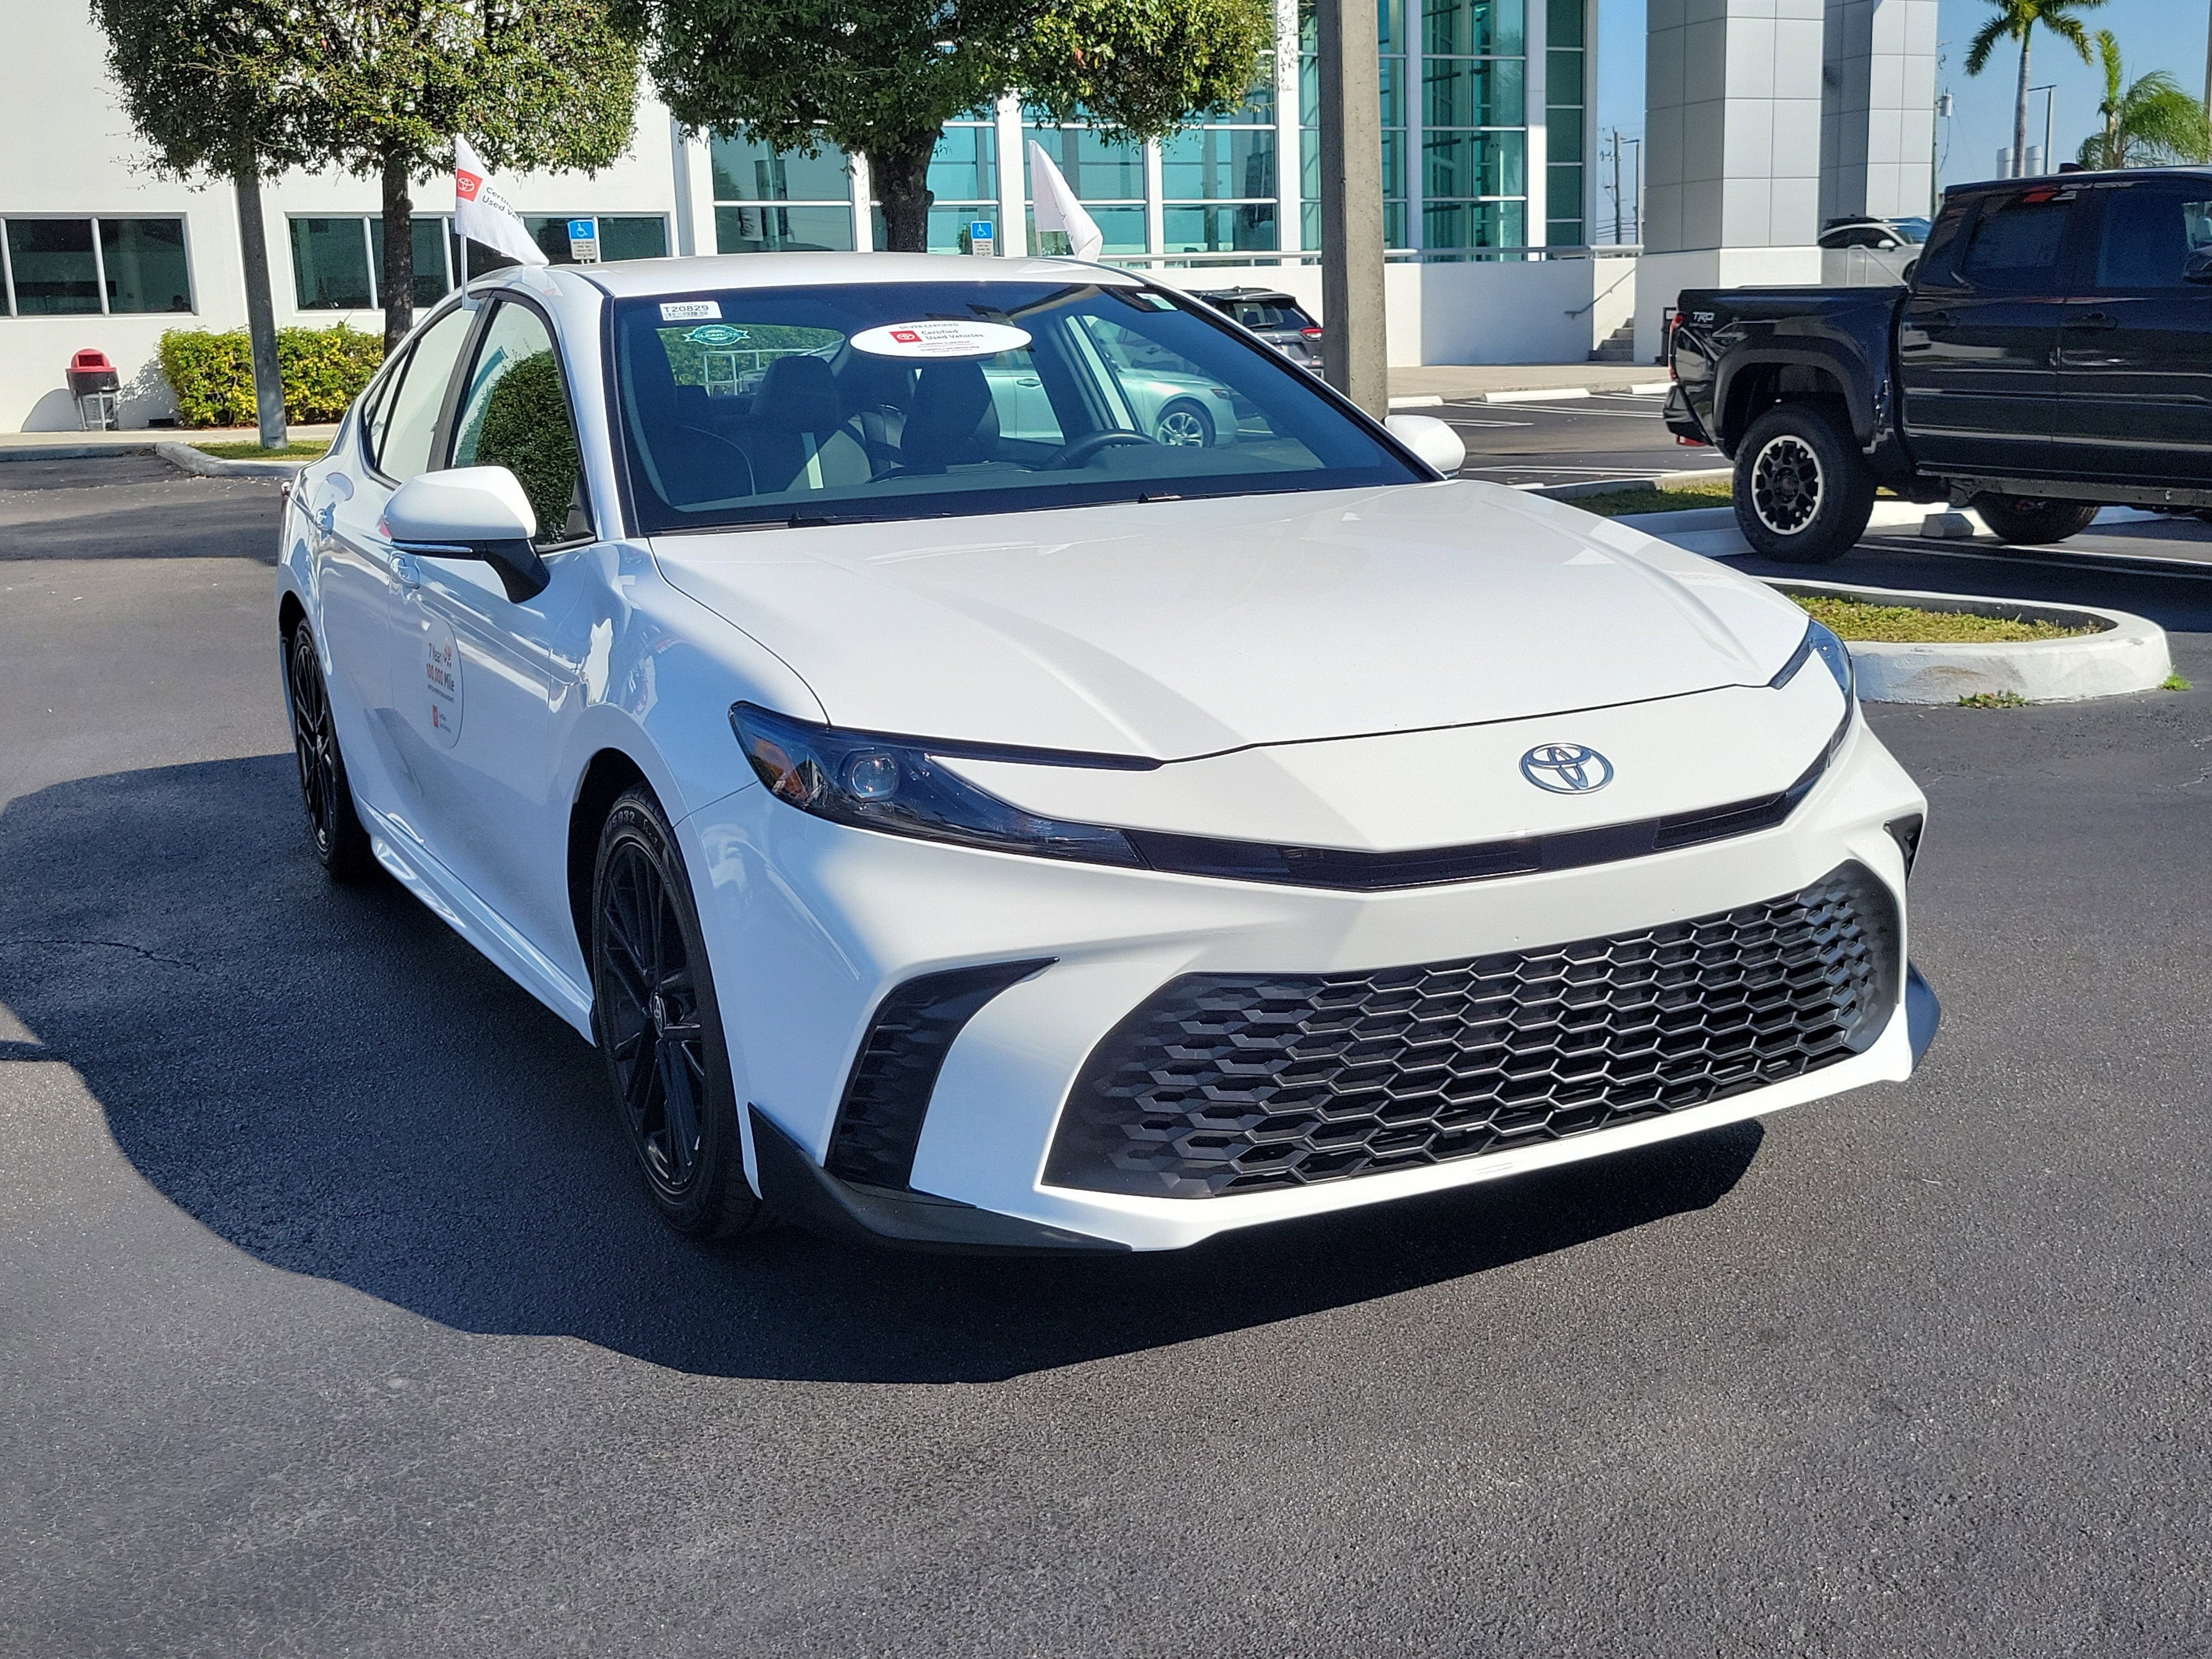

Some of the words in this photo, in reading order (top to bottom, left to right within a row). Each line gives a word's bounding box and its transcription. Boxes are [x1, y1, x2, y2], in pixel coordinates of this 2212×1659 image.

[482, 195, 506, 211] Used
[663, 304, 709, 313] T20829
[1692, 312, 1715, 323] TRD
